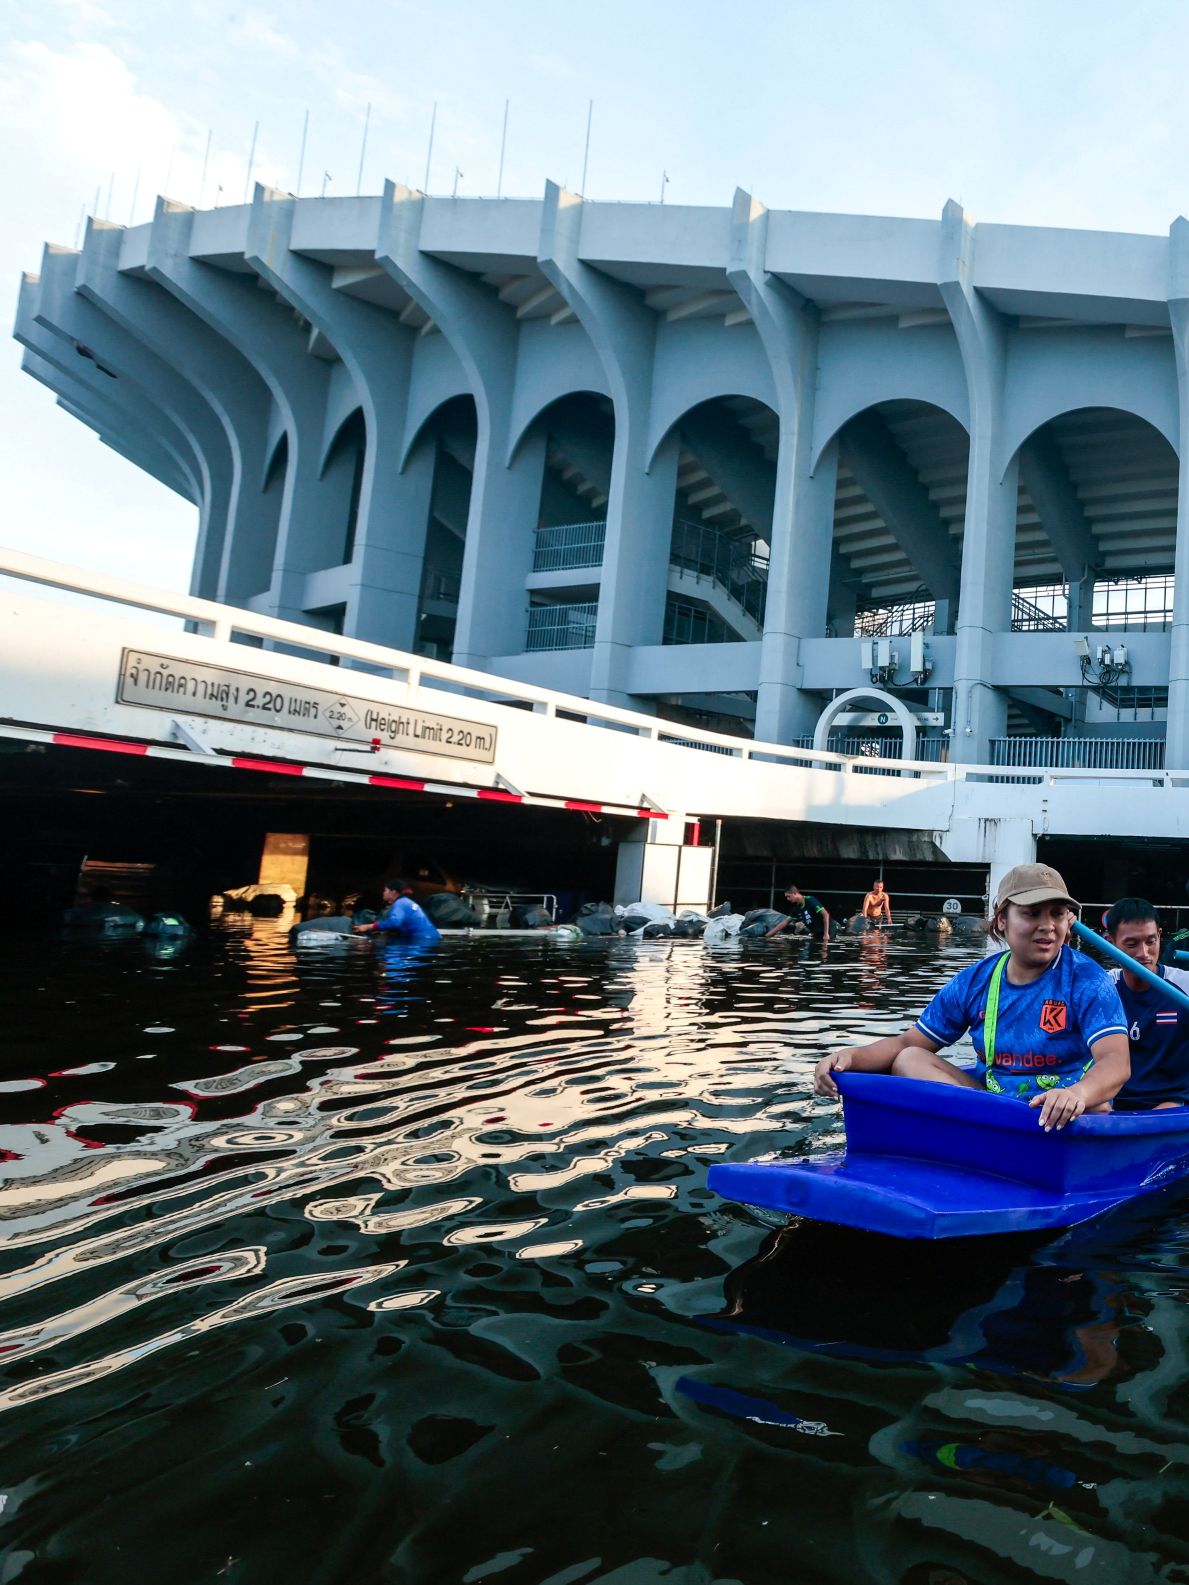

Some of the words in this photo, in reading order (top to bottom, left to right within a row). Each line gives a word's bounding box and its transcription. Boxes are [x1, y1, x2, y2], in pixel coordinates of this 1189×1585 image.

[130, 657, 239, 711] จำกัดความสูง
[244, 688, 284, 713] 2.20
[288, 696, 320, 719] เมตร
[328, 710, 347, 721] 2.20
[364, 708, 410, 740] (Height
[413, 718, 443, 743] Limit
[446, 727, 473, 747] 2.20
[474, 732, 494, 752] m.)
[946, 902, 959, 910] 30
[1130, 1021, 1141, 1041] 6
